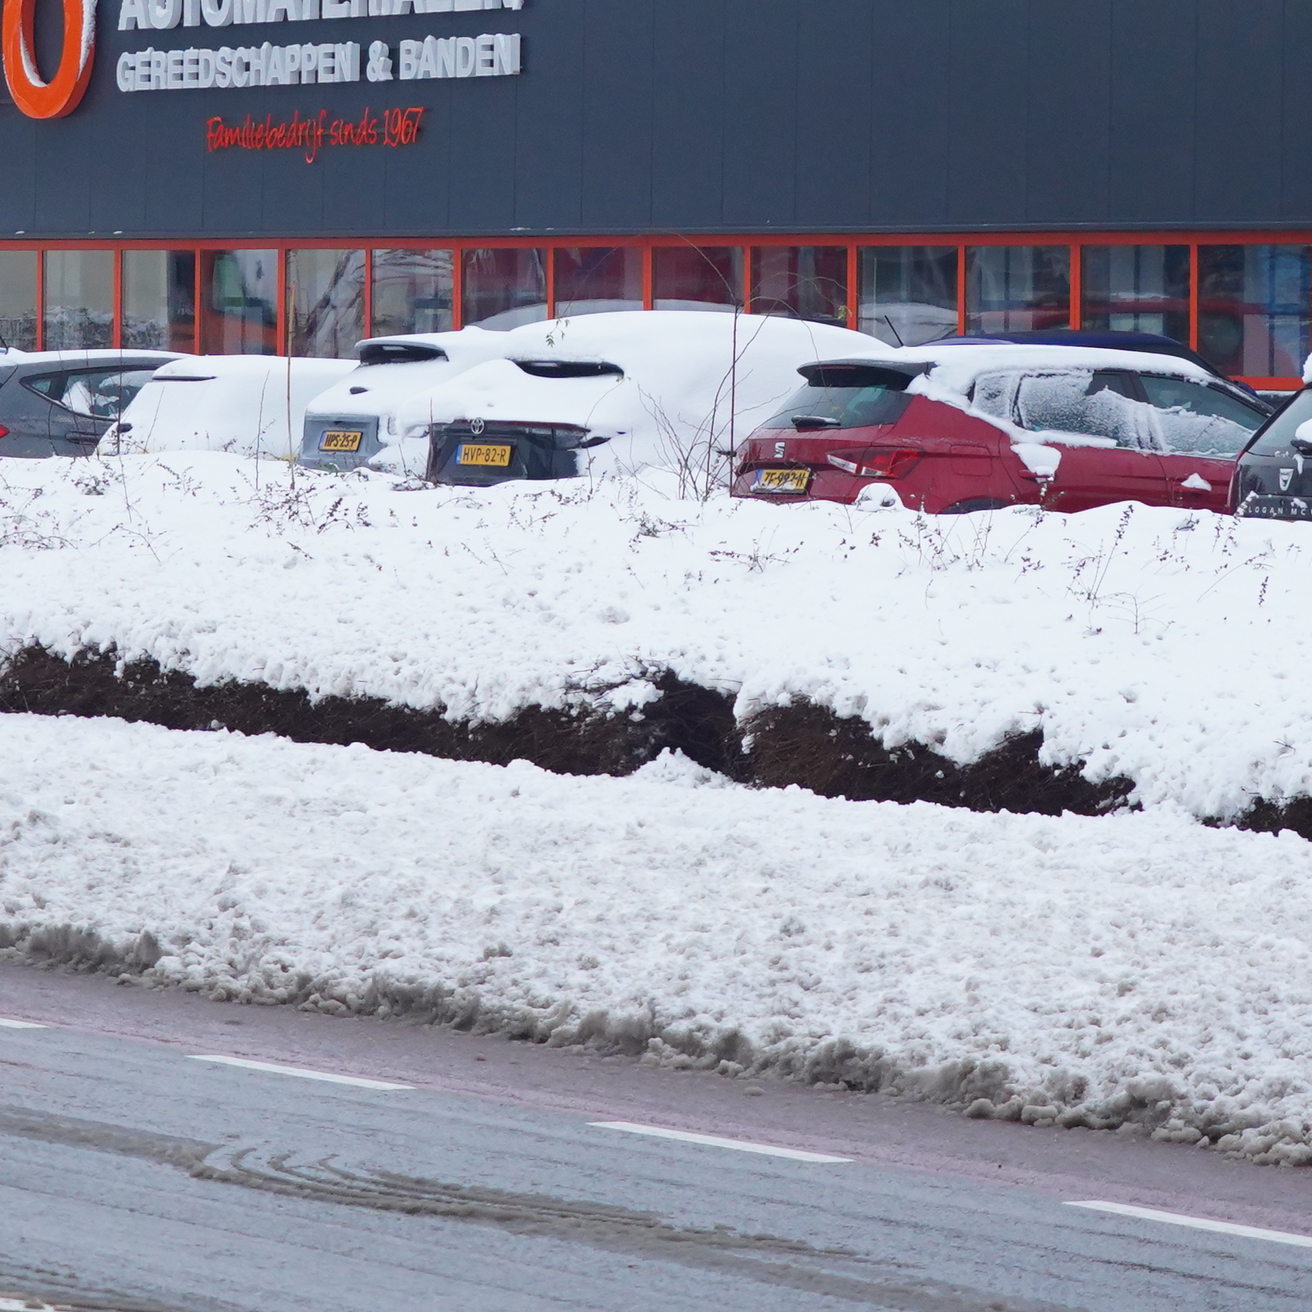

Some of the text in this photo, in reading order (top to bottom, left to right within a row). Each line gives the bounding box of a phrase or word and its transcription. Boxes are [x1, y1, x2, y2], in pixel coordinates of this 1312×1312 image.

[116, 35, 520, 92] GEREEDSCHAPPEN & BANDEN
[206, 106, 425, 164] Familiebedrijf sinds 1967
[462, 446, 506, 463] HVP-82-R
[1248, 506, 1283, 515] LOGAN
